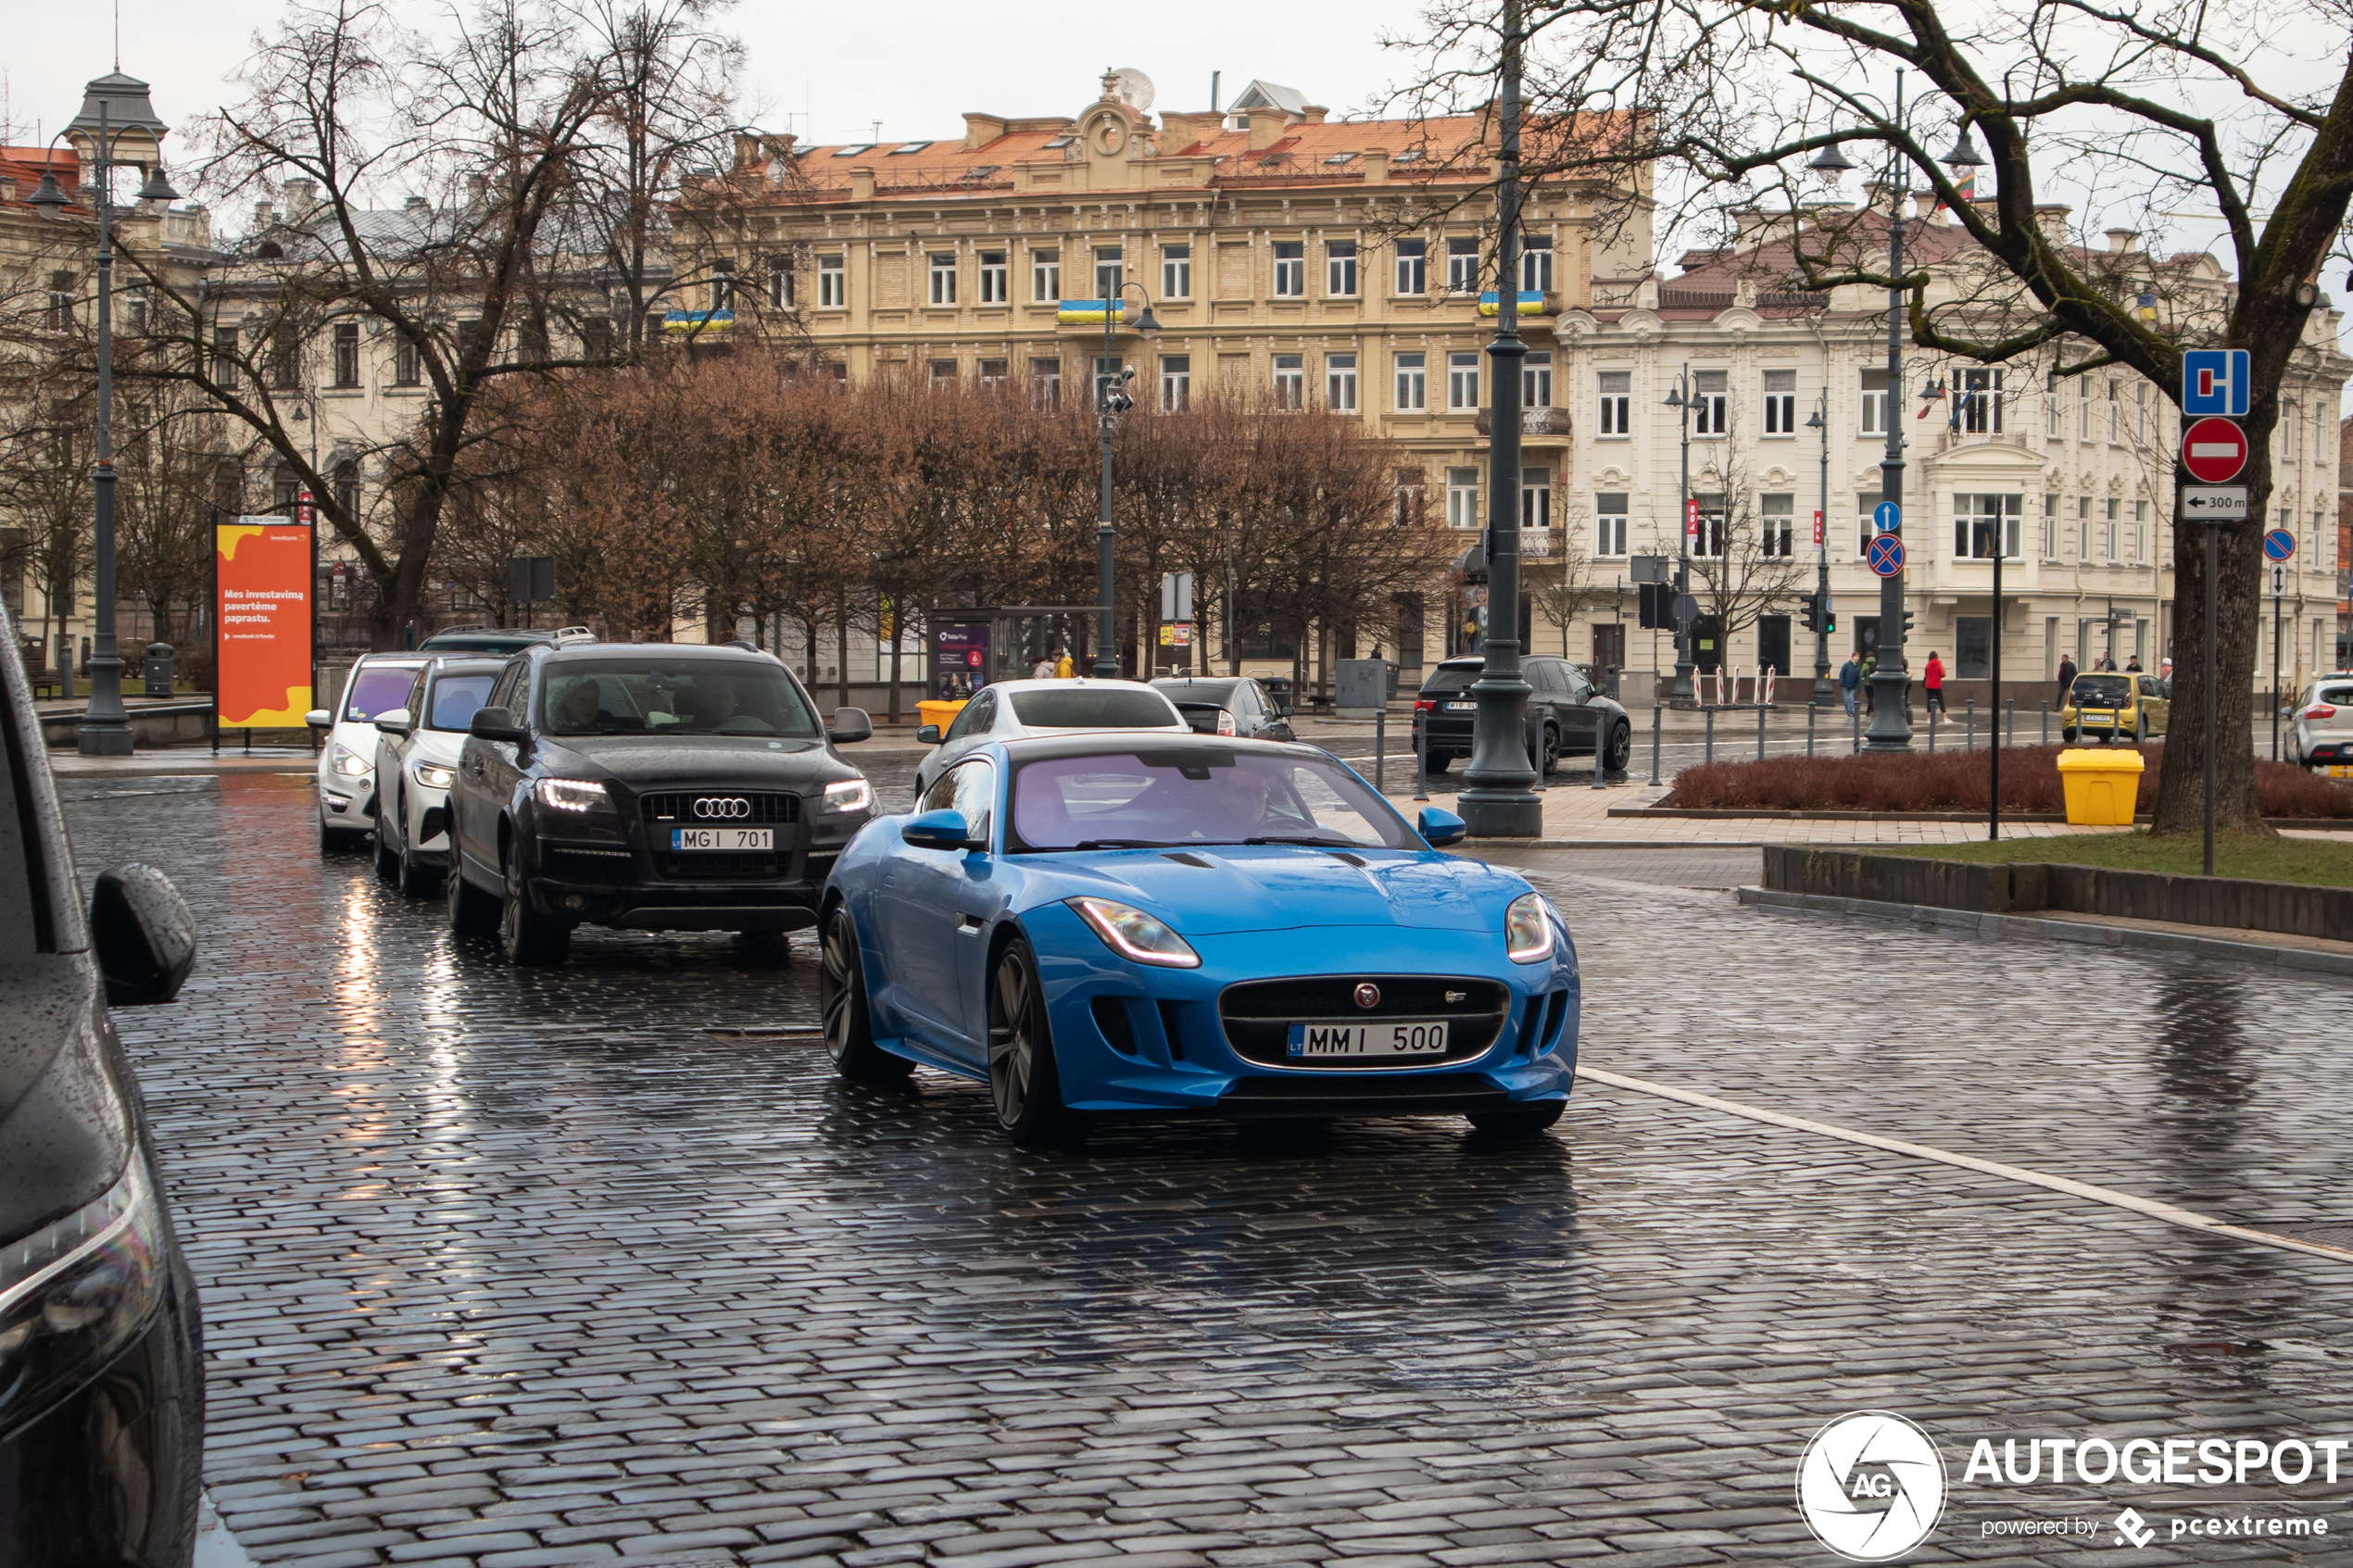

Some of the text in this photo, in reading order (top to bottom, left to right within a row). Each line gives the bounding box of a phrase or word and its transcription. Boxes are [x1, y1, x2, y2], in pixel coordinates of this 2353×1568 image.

[2209, 497, 2232, 508] 300
[225, 589, 304, 601] Mes investavimą
[225, 601, 277, 612] pavertėme
[225, 614, 271, 624] paprastu.
[685, 831, 720, 847] MGI
[737, 831, 768, 847] 701
[1308, 1028, 1365, 1053] MMI
[1393, 1024, 1443, 1051] 500
